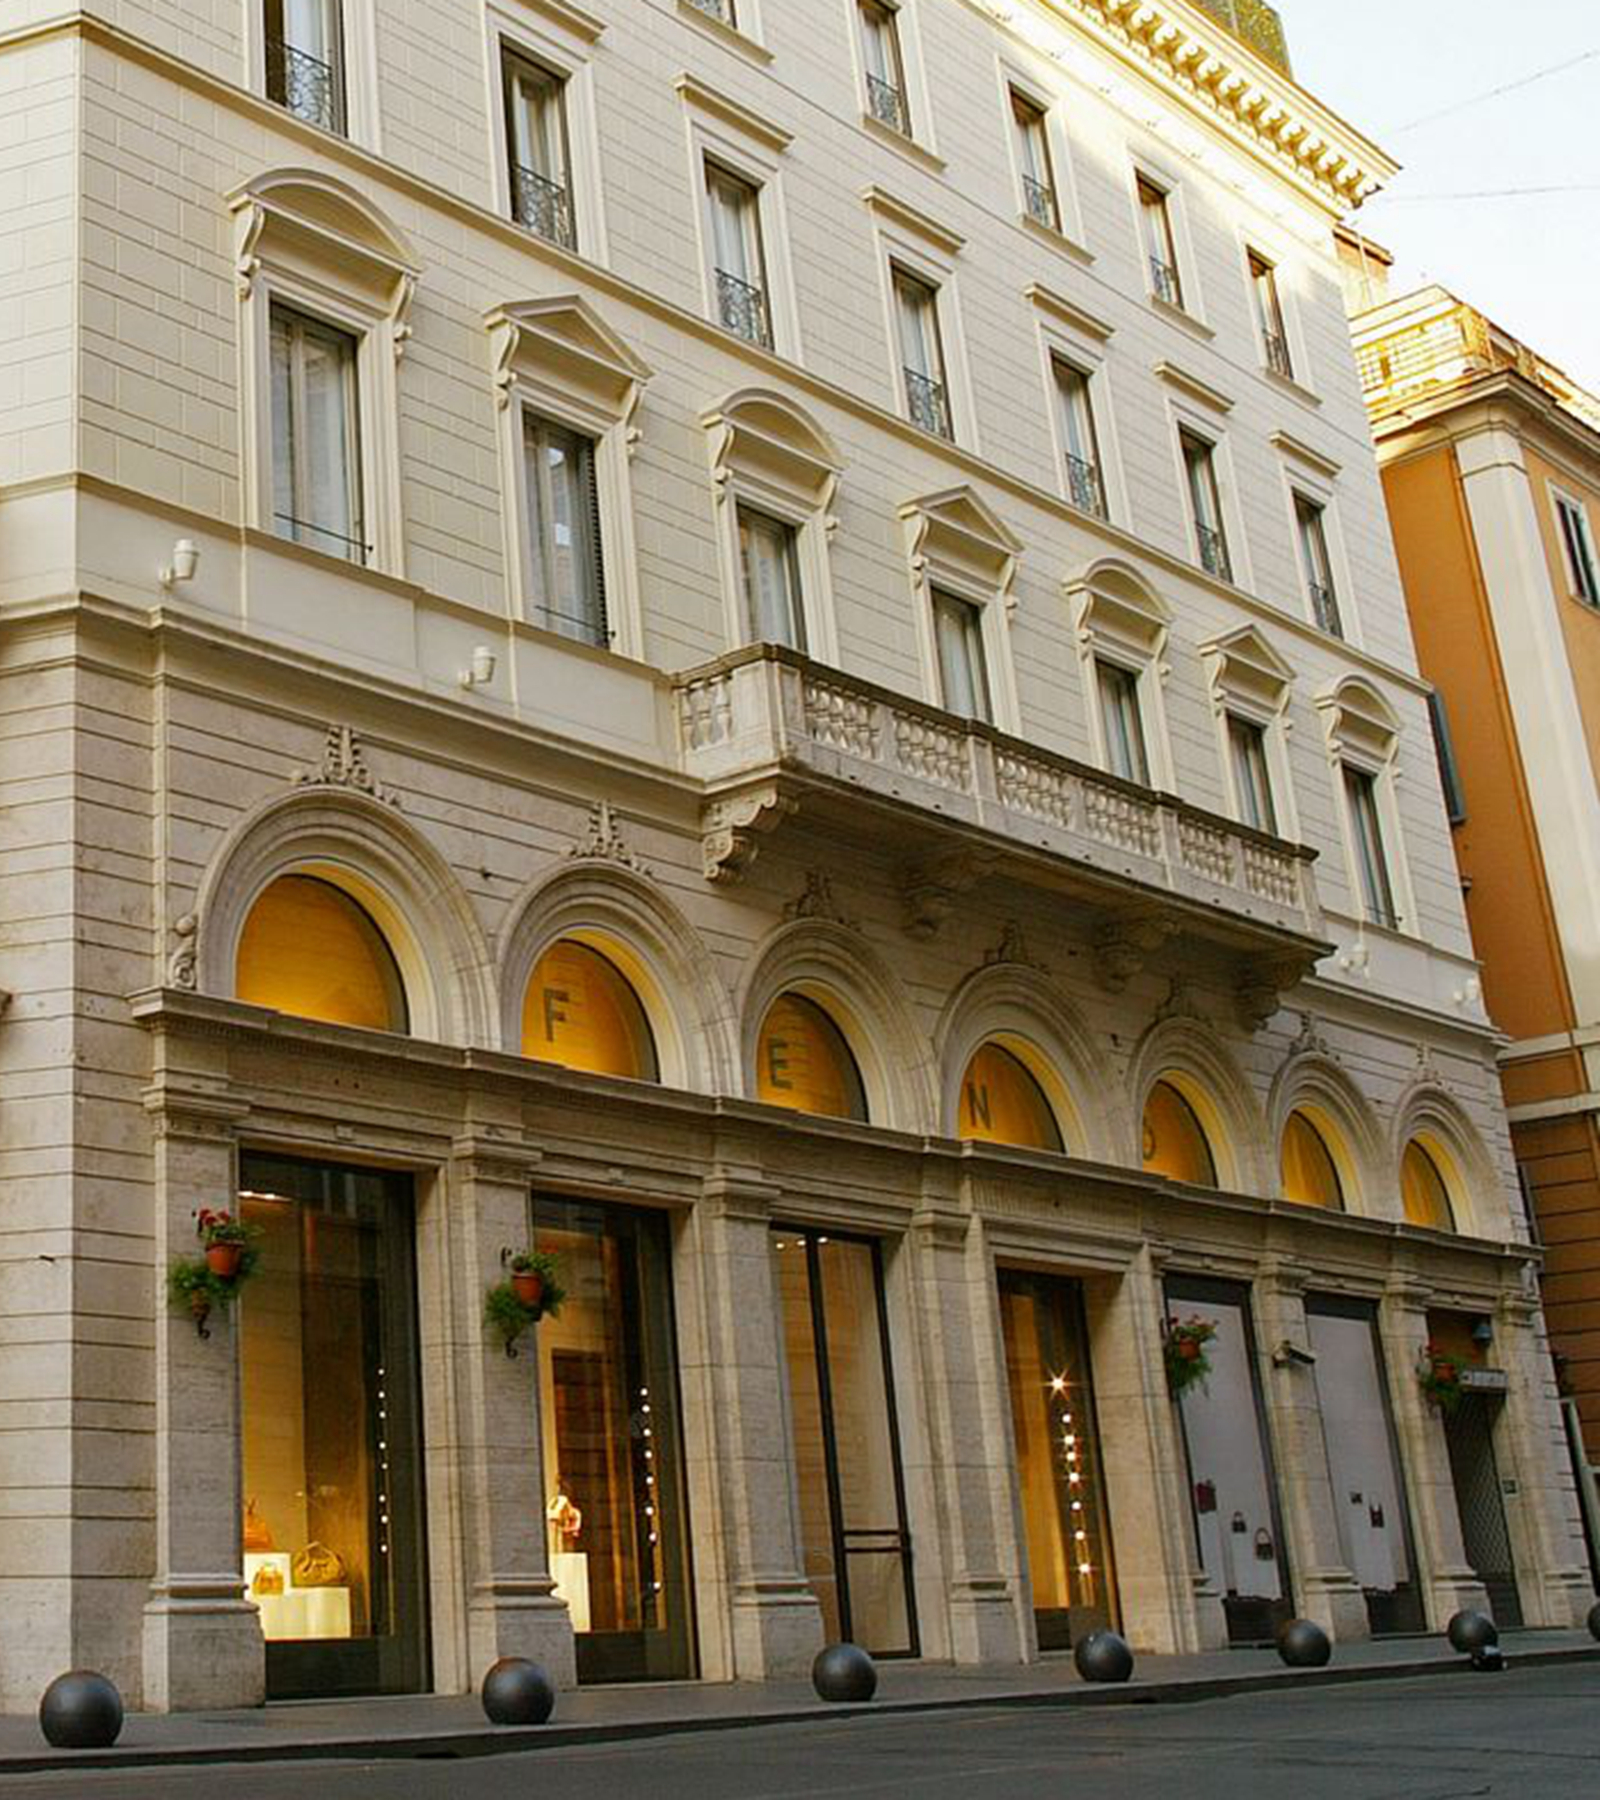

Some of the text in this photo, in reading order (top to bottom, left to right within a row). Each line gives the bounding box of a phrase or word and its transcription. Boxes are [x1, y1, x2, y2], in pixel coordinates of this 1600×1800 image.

[543, 987, 570, 1042] F
[768, 1037, 794, 1090] E
[966, 1081, 992, 1131] N
